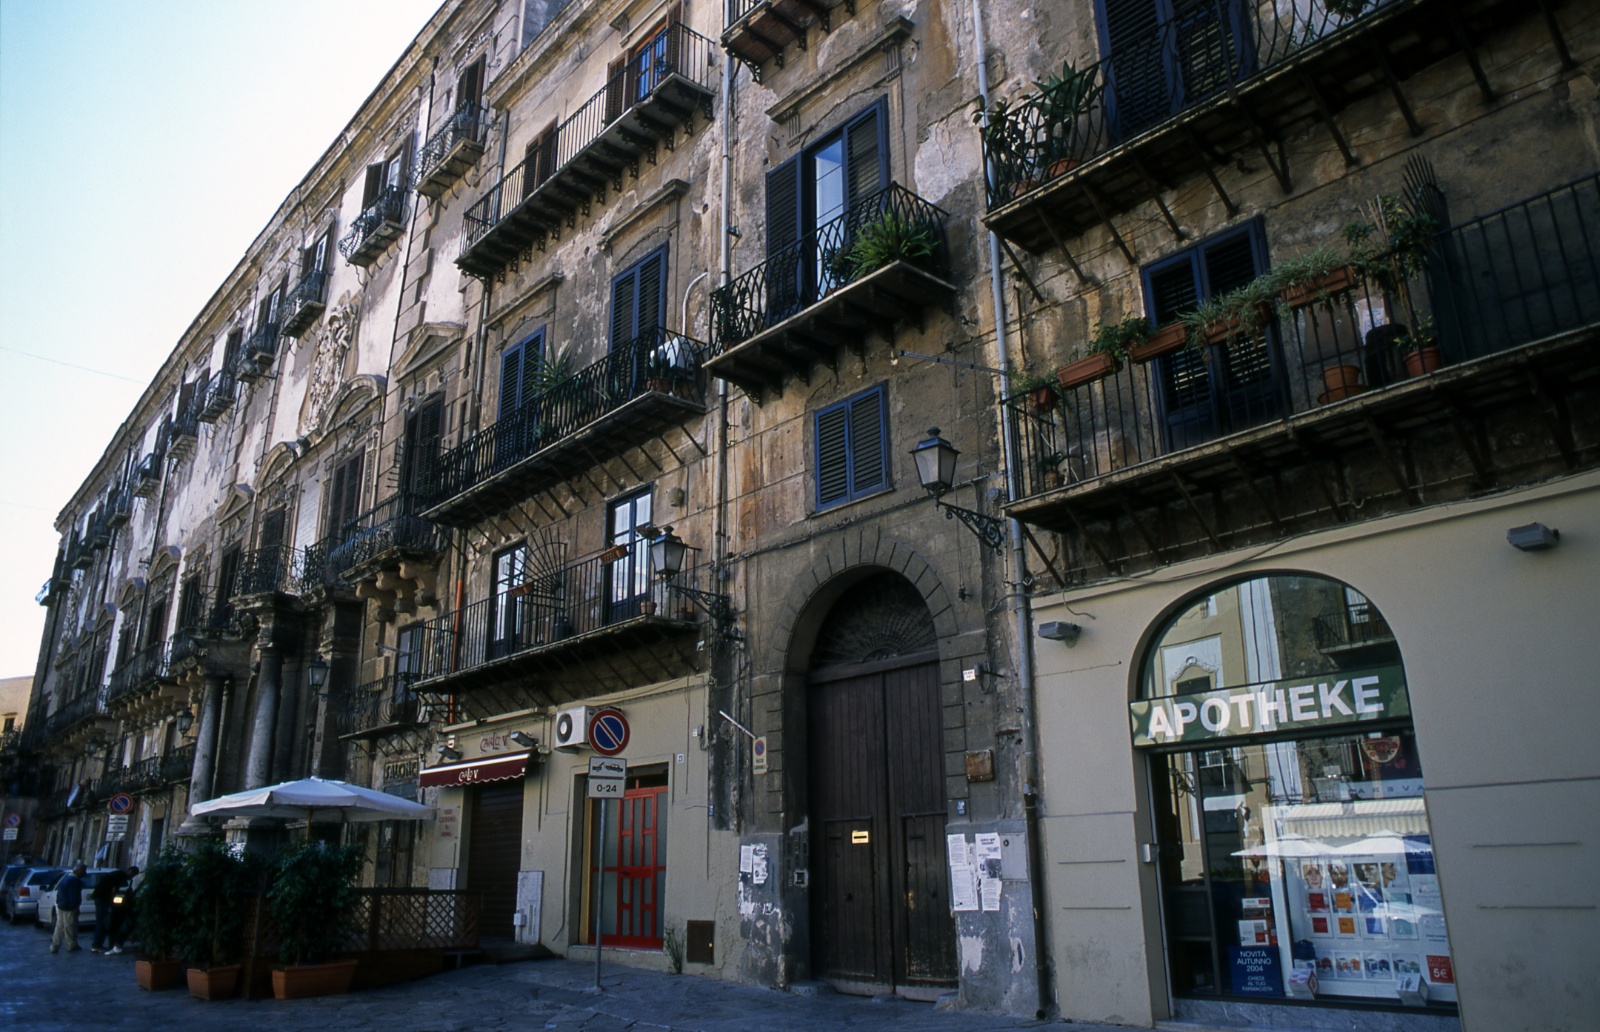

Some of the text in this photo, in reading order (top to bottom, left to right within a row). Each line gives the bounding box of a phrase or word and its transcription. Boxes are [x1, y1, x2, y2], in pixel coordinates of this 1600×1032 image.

[1147, 675, 1384, 739] APOTHEKE
[596, 784, 617, 792] 0-24
[1240, 950, 1267, 958] NOVITÀ
[1433, 967, 1448, 979] 5€
